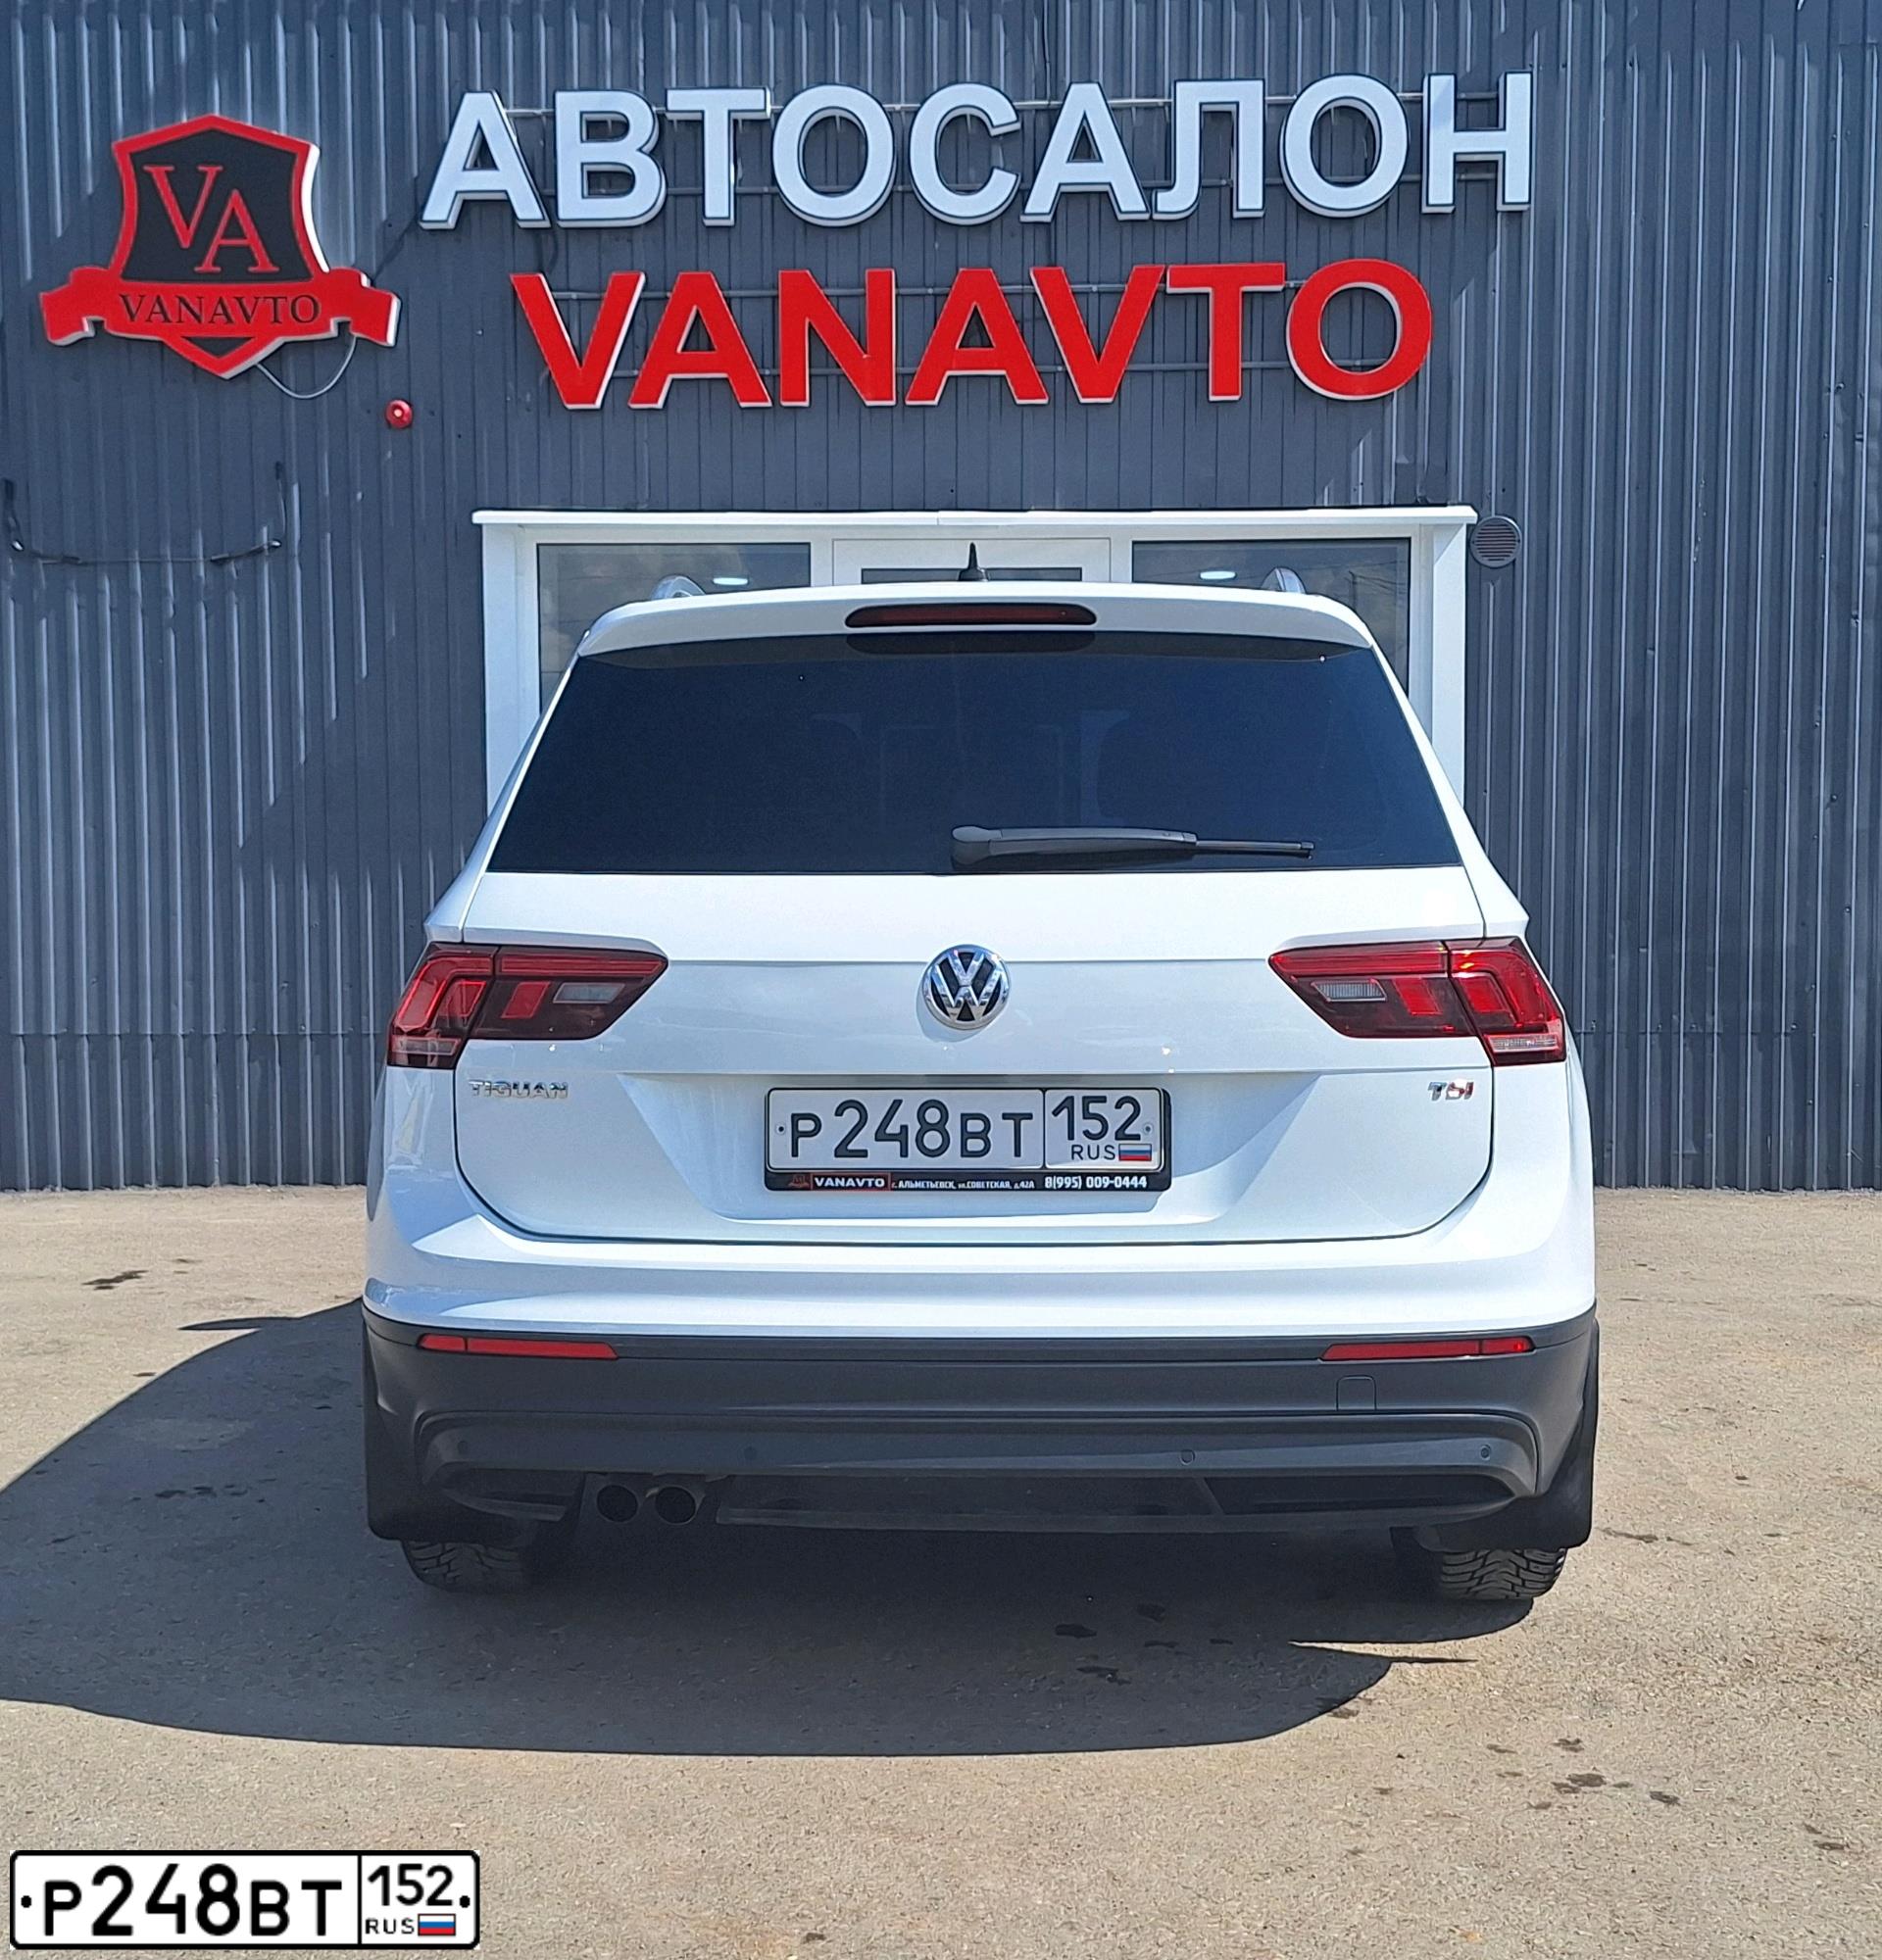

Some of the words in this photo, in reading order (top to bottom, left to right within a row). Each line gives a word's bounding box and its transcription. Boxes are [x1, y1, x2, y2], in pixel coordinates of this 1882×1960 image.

[420, 73, 1532, 231] АВТОСАЛОН
[143, 165, 280, 274] VA
[119, 293, 322, 326] VANAVTO
[510, 258, 1433, 412] VANAVTO
[469, 1079, 569, 1099] TIGUAN
[1051, 1095, 1142, 1142] 152
[1070, 1144, 1115, 1161] RUS
[814, 1177, 885, 1189] VANAVTO
[1044, 1176, 1082, 1190] 8(995)
[1085, 1176, 1147, 1189] 009-0444
